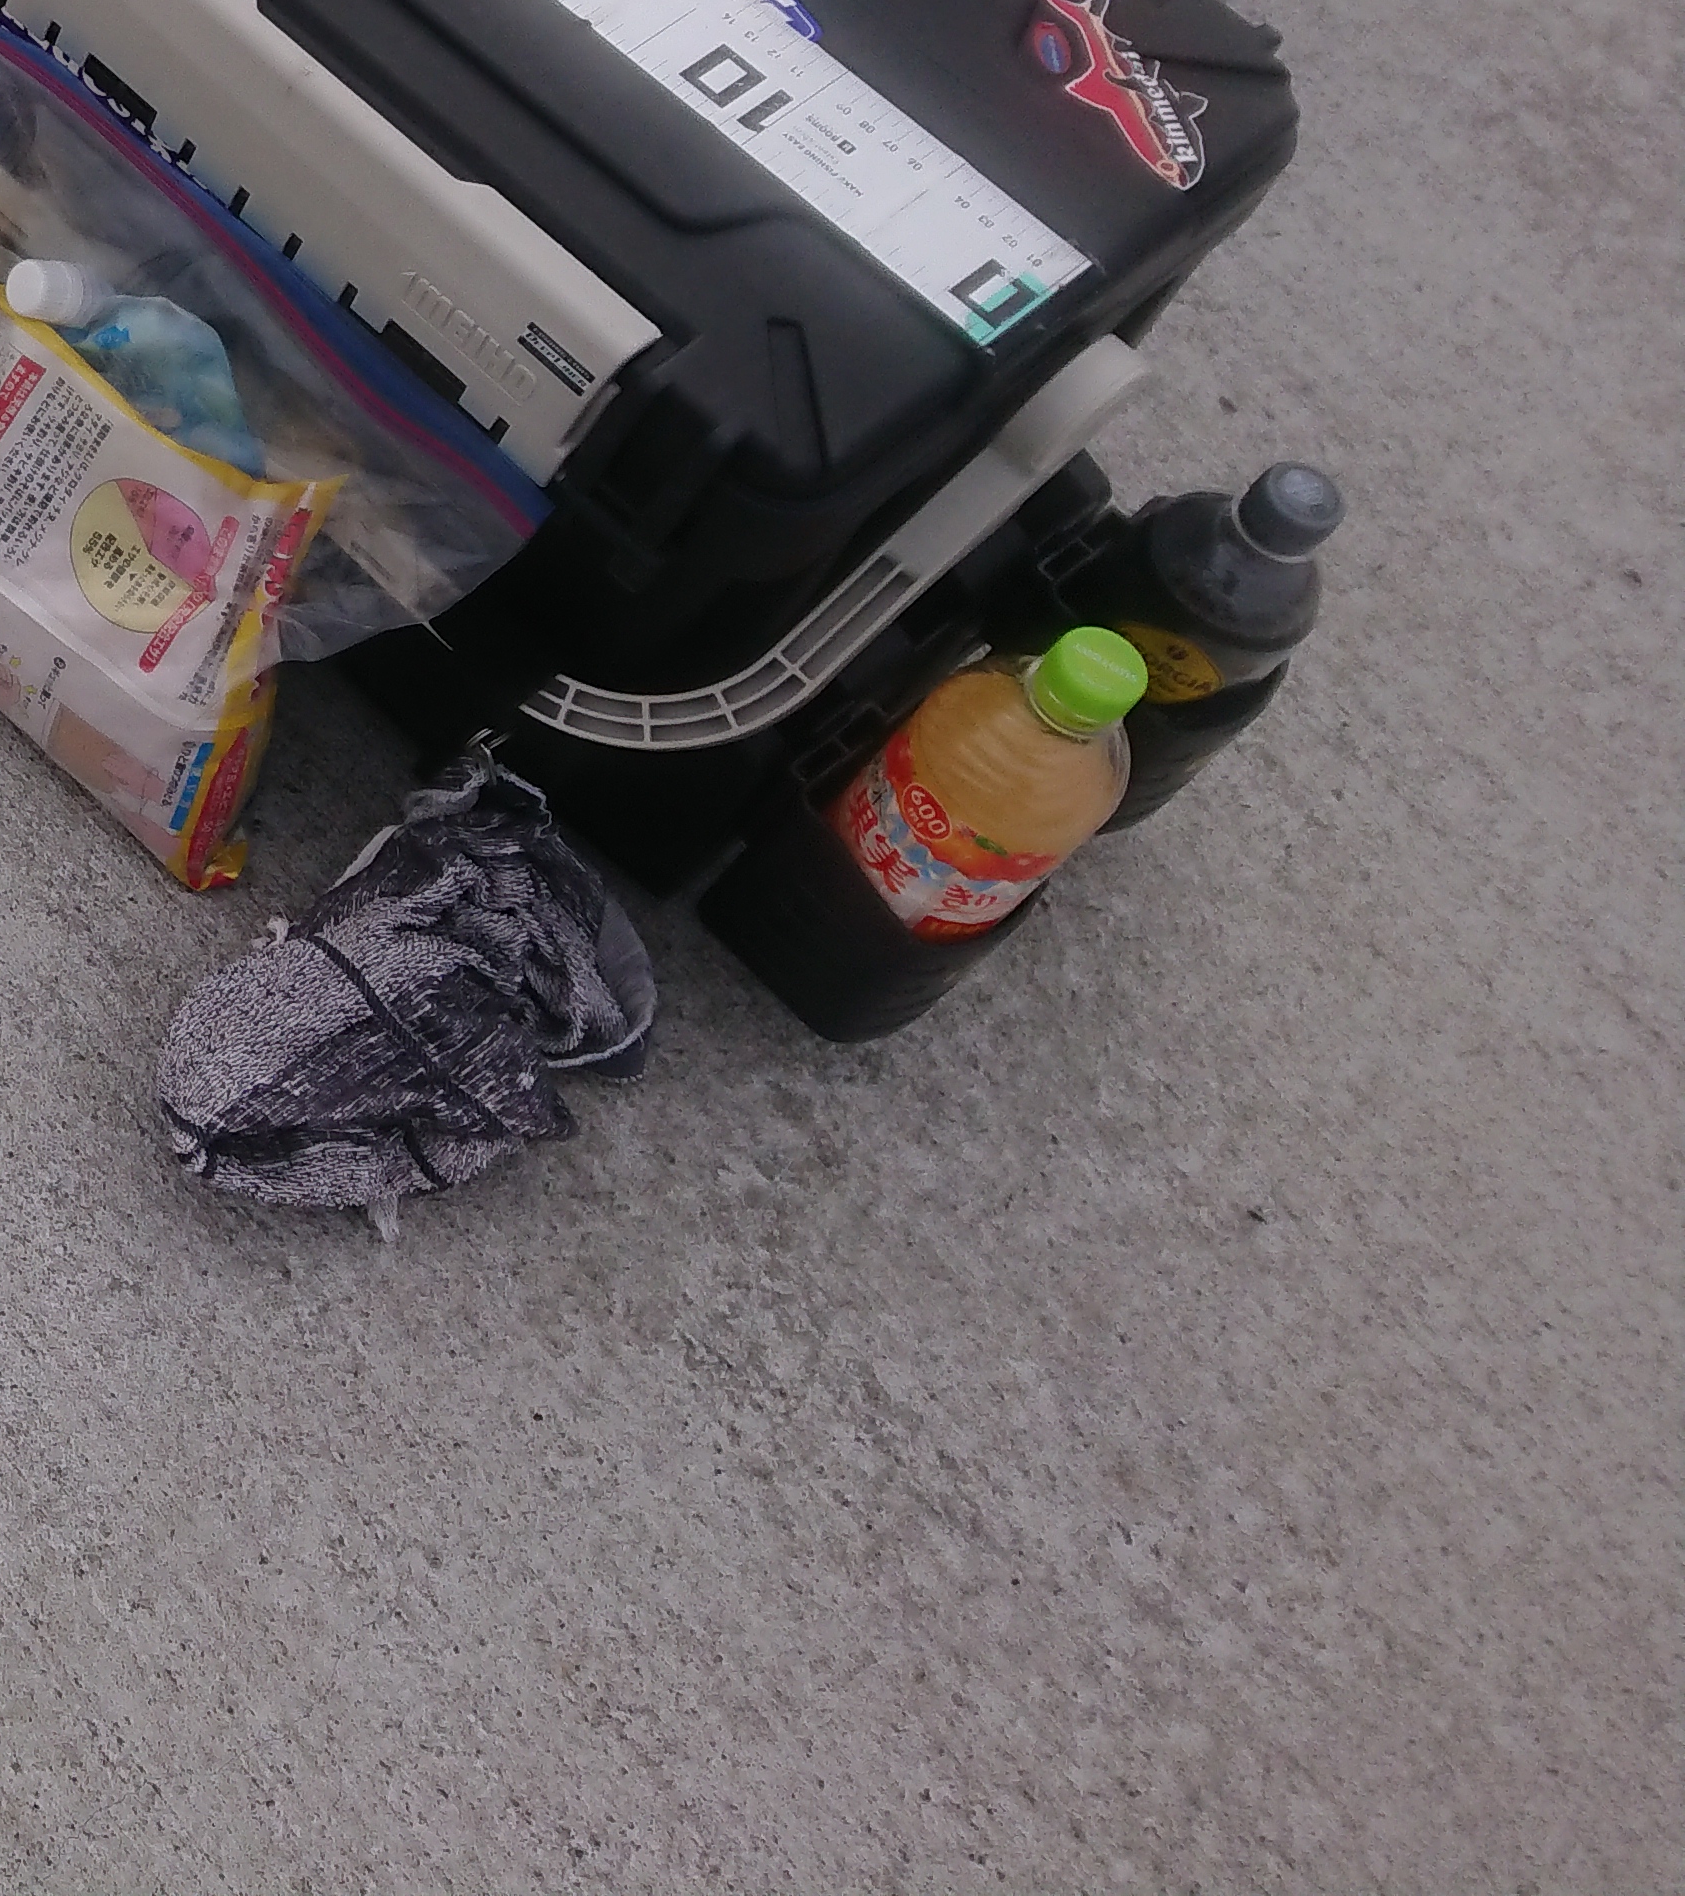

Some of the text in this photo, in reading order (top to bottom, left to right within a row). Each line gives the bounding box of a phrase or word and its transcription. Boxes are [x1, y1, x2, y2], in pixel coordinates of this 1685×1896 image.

[743, 30, 759, 43] 13
[790, 66, 803, 78] 11
[680, 43, 793, 132] 10
[859, 122, 875, 134] 08
[780, 128, 806, 152] EASY
[883, 140, 899, 152] 07
[906, 158, 922, 171] 06
[954, 195, 970, 209] 04
[978, 215, 995, 228] 03
[1002, 234, 1018, 248] 02
[1025, 254, 1042, 267] 01
[81, 529, 103, 556] 55%
[908, 788, 949, 839] 600
[847, 790, 919, 894] 果実
